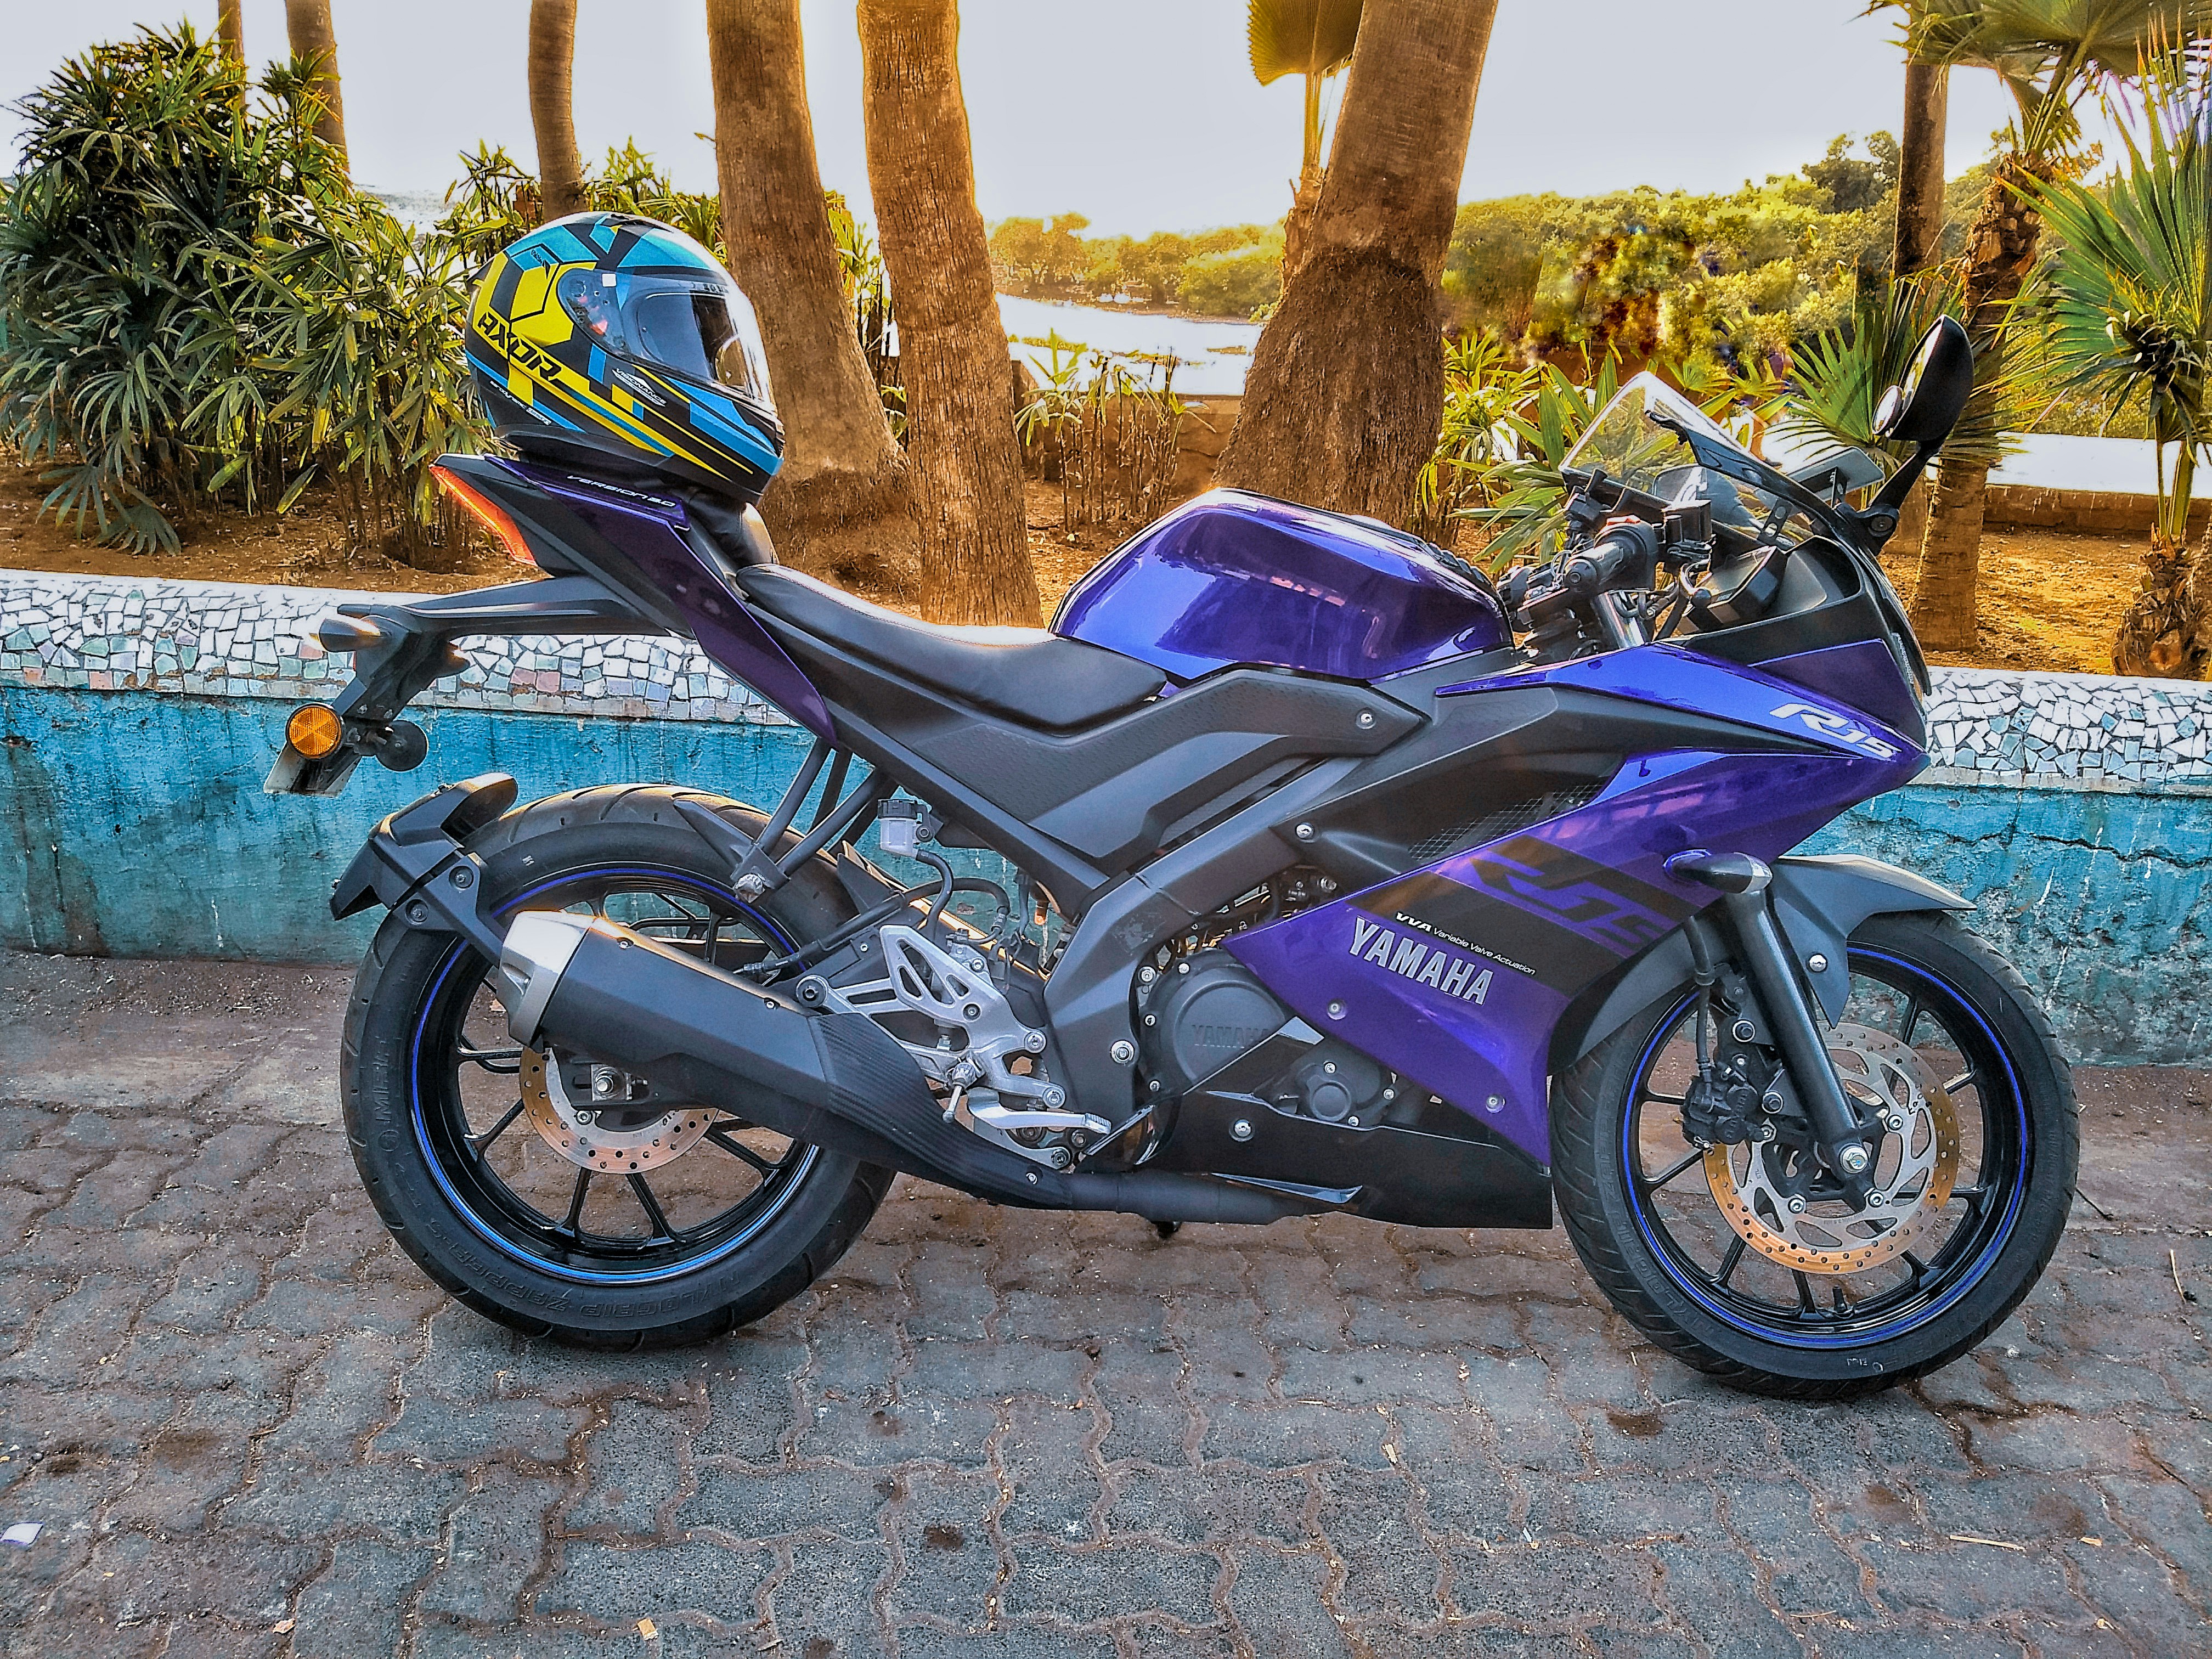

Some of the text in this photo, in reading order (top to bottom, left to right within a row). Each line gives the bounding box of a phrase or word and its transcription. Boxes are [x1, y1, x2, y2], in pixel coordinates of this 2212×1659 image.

[477, 312, 562, 381] AXOR
[616, 368, 667, 404] VISIONANCE
[1769, 703, 1902, 760] R15
[1348, 916, 1495, 1005] YAMAHA
[1396, 912, 1536, 975] VVA Variable Valve Actuation
